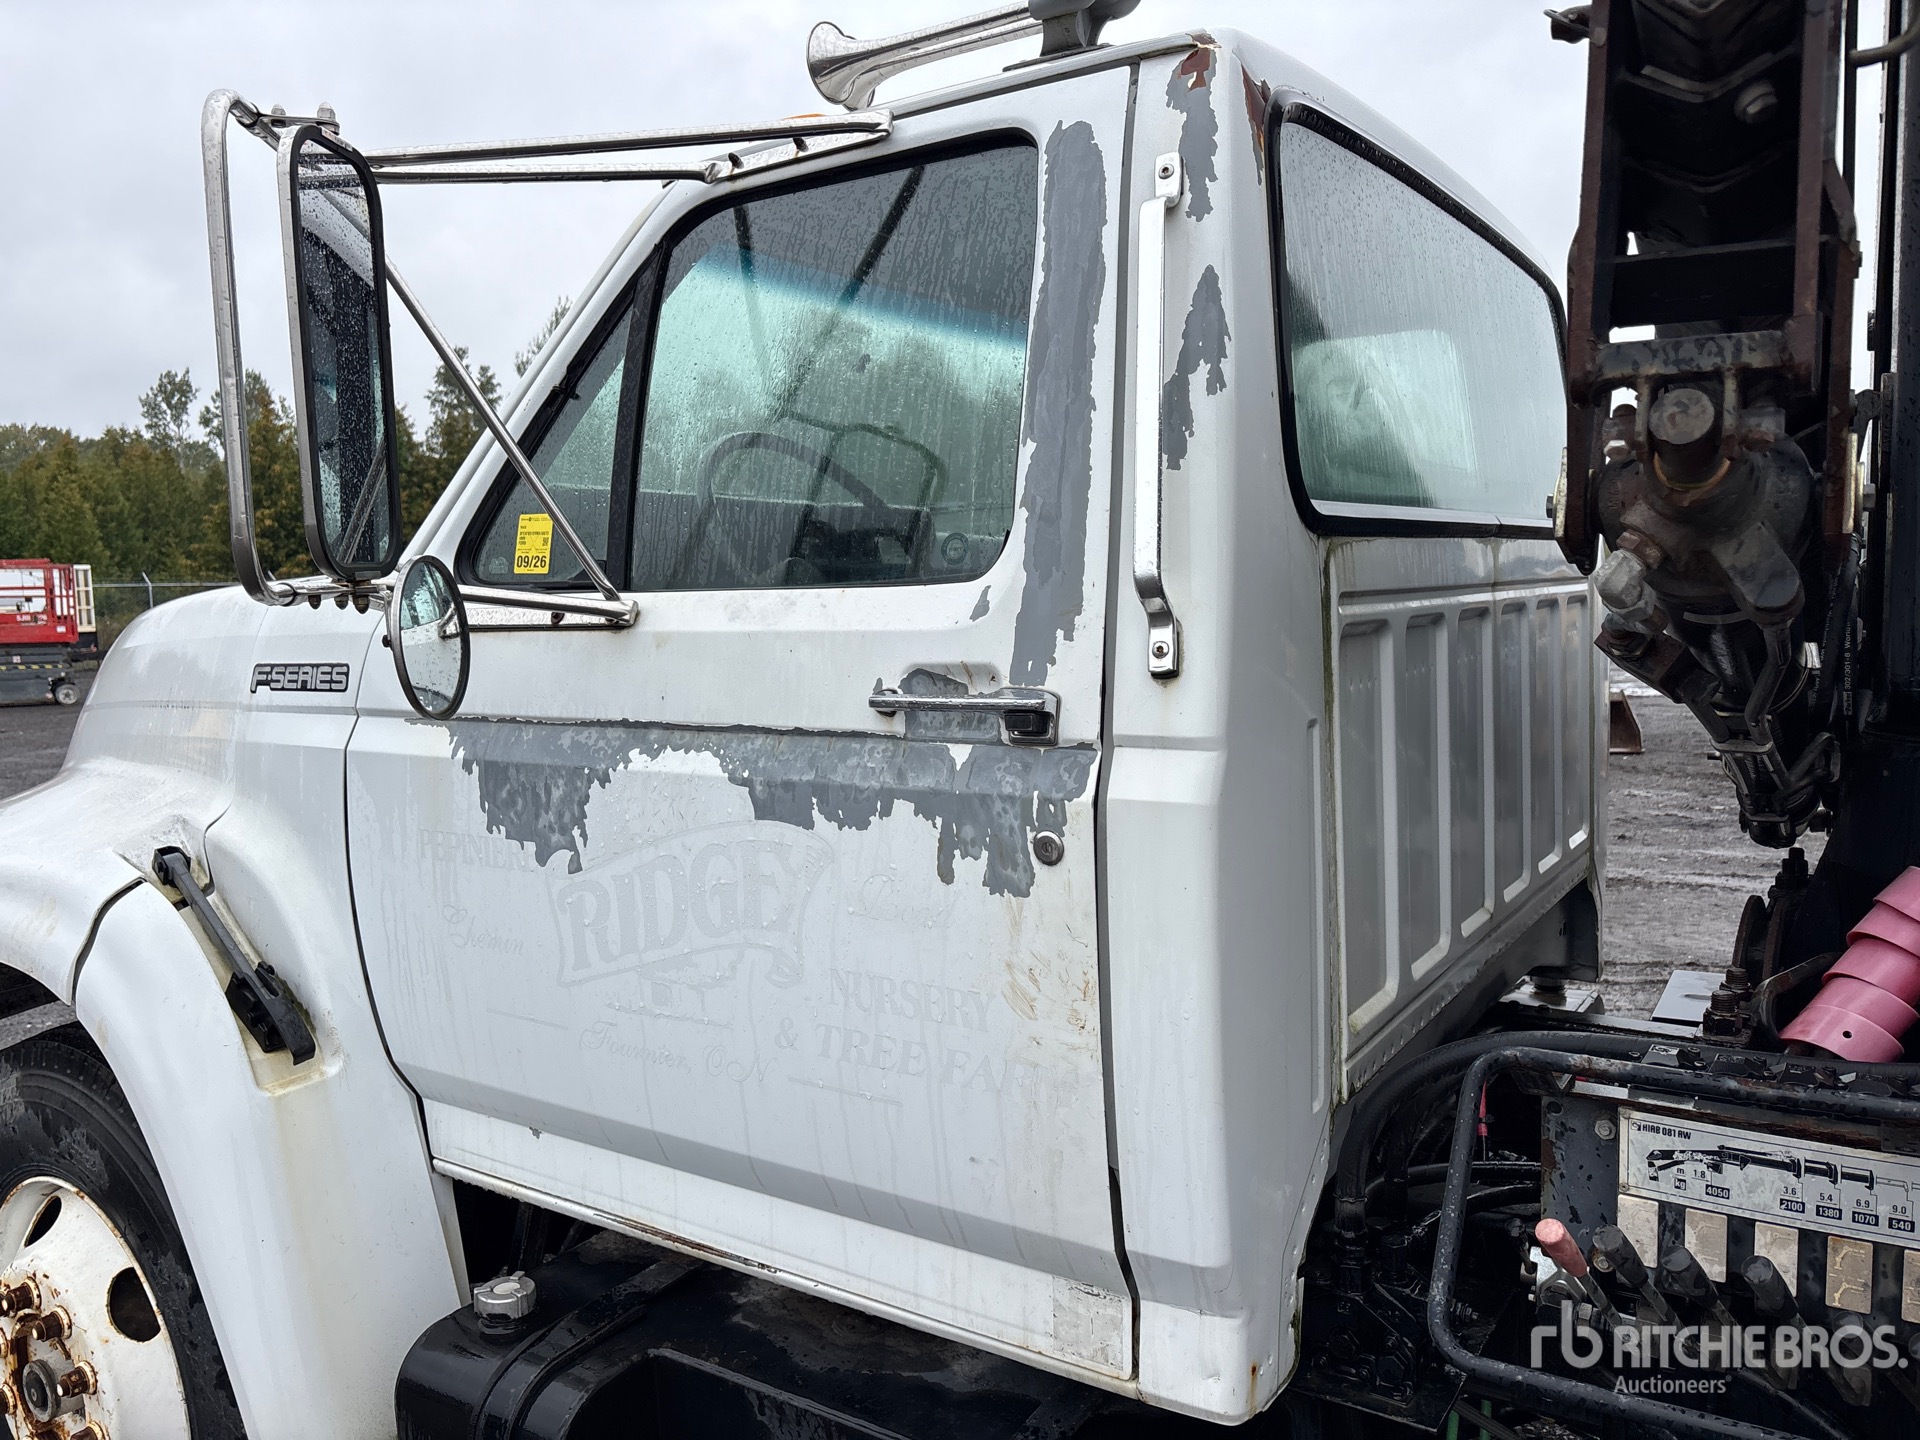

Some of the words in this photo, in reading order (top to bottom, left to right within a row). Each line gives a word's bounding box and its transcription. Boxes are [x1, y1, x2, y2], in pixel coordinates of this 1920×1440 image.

[516, 555, 547, 569] 09/26
[556, 837, 798, 971] RIDGE
[828, 968, 998, 1034] NURSERY
[773, 1018, 799, 1051] &
[816, 1023, 930, 1078] TREE
[1642, 1123, 1661, 1135] HIAB
[1662, 1126, 1676, 1138] 081
[1677, 1129, 1692, 1140] RW
[1676, 1167, 1685, 1175] m
[1693, 1169, 1706, 1179] 1.8
[1675, 1179, 1686, 1190] kg
[1706, 1185, 1729, 1199] 4050
[1783, 1186, 1797, 1196] 3.6
[1819, 1192, 1833, 1202] 5.4
[1780, 1200, 1803, 1212] 2100
[1855, 1198, 1870, 1209] 6.9
[1892, 1204, 1907, 1215] 9.0
[1818, 1206, 1840, 1219] 1380
[1854, 1213, 1876, 1225] 1070
[1892, 1221, 1912, 1231] 540
